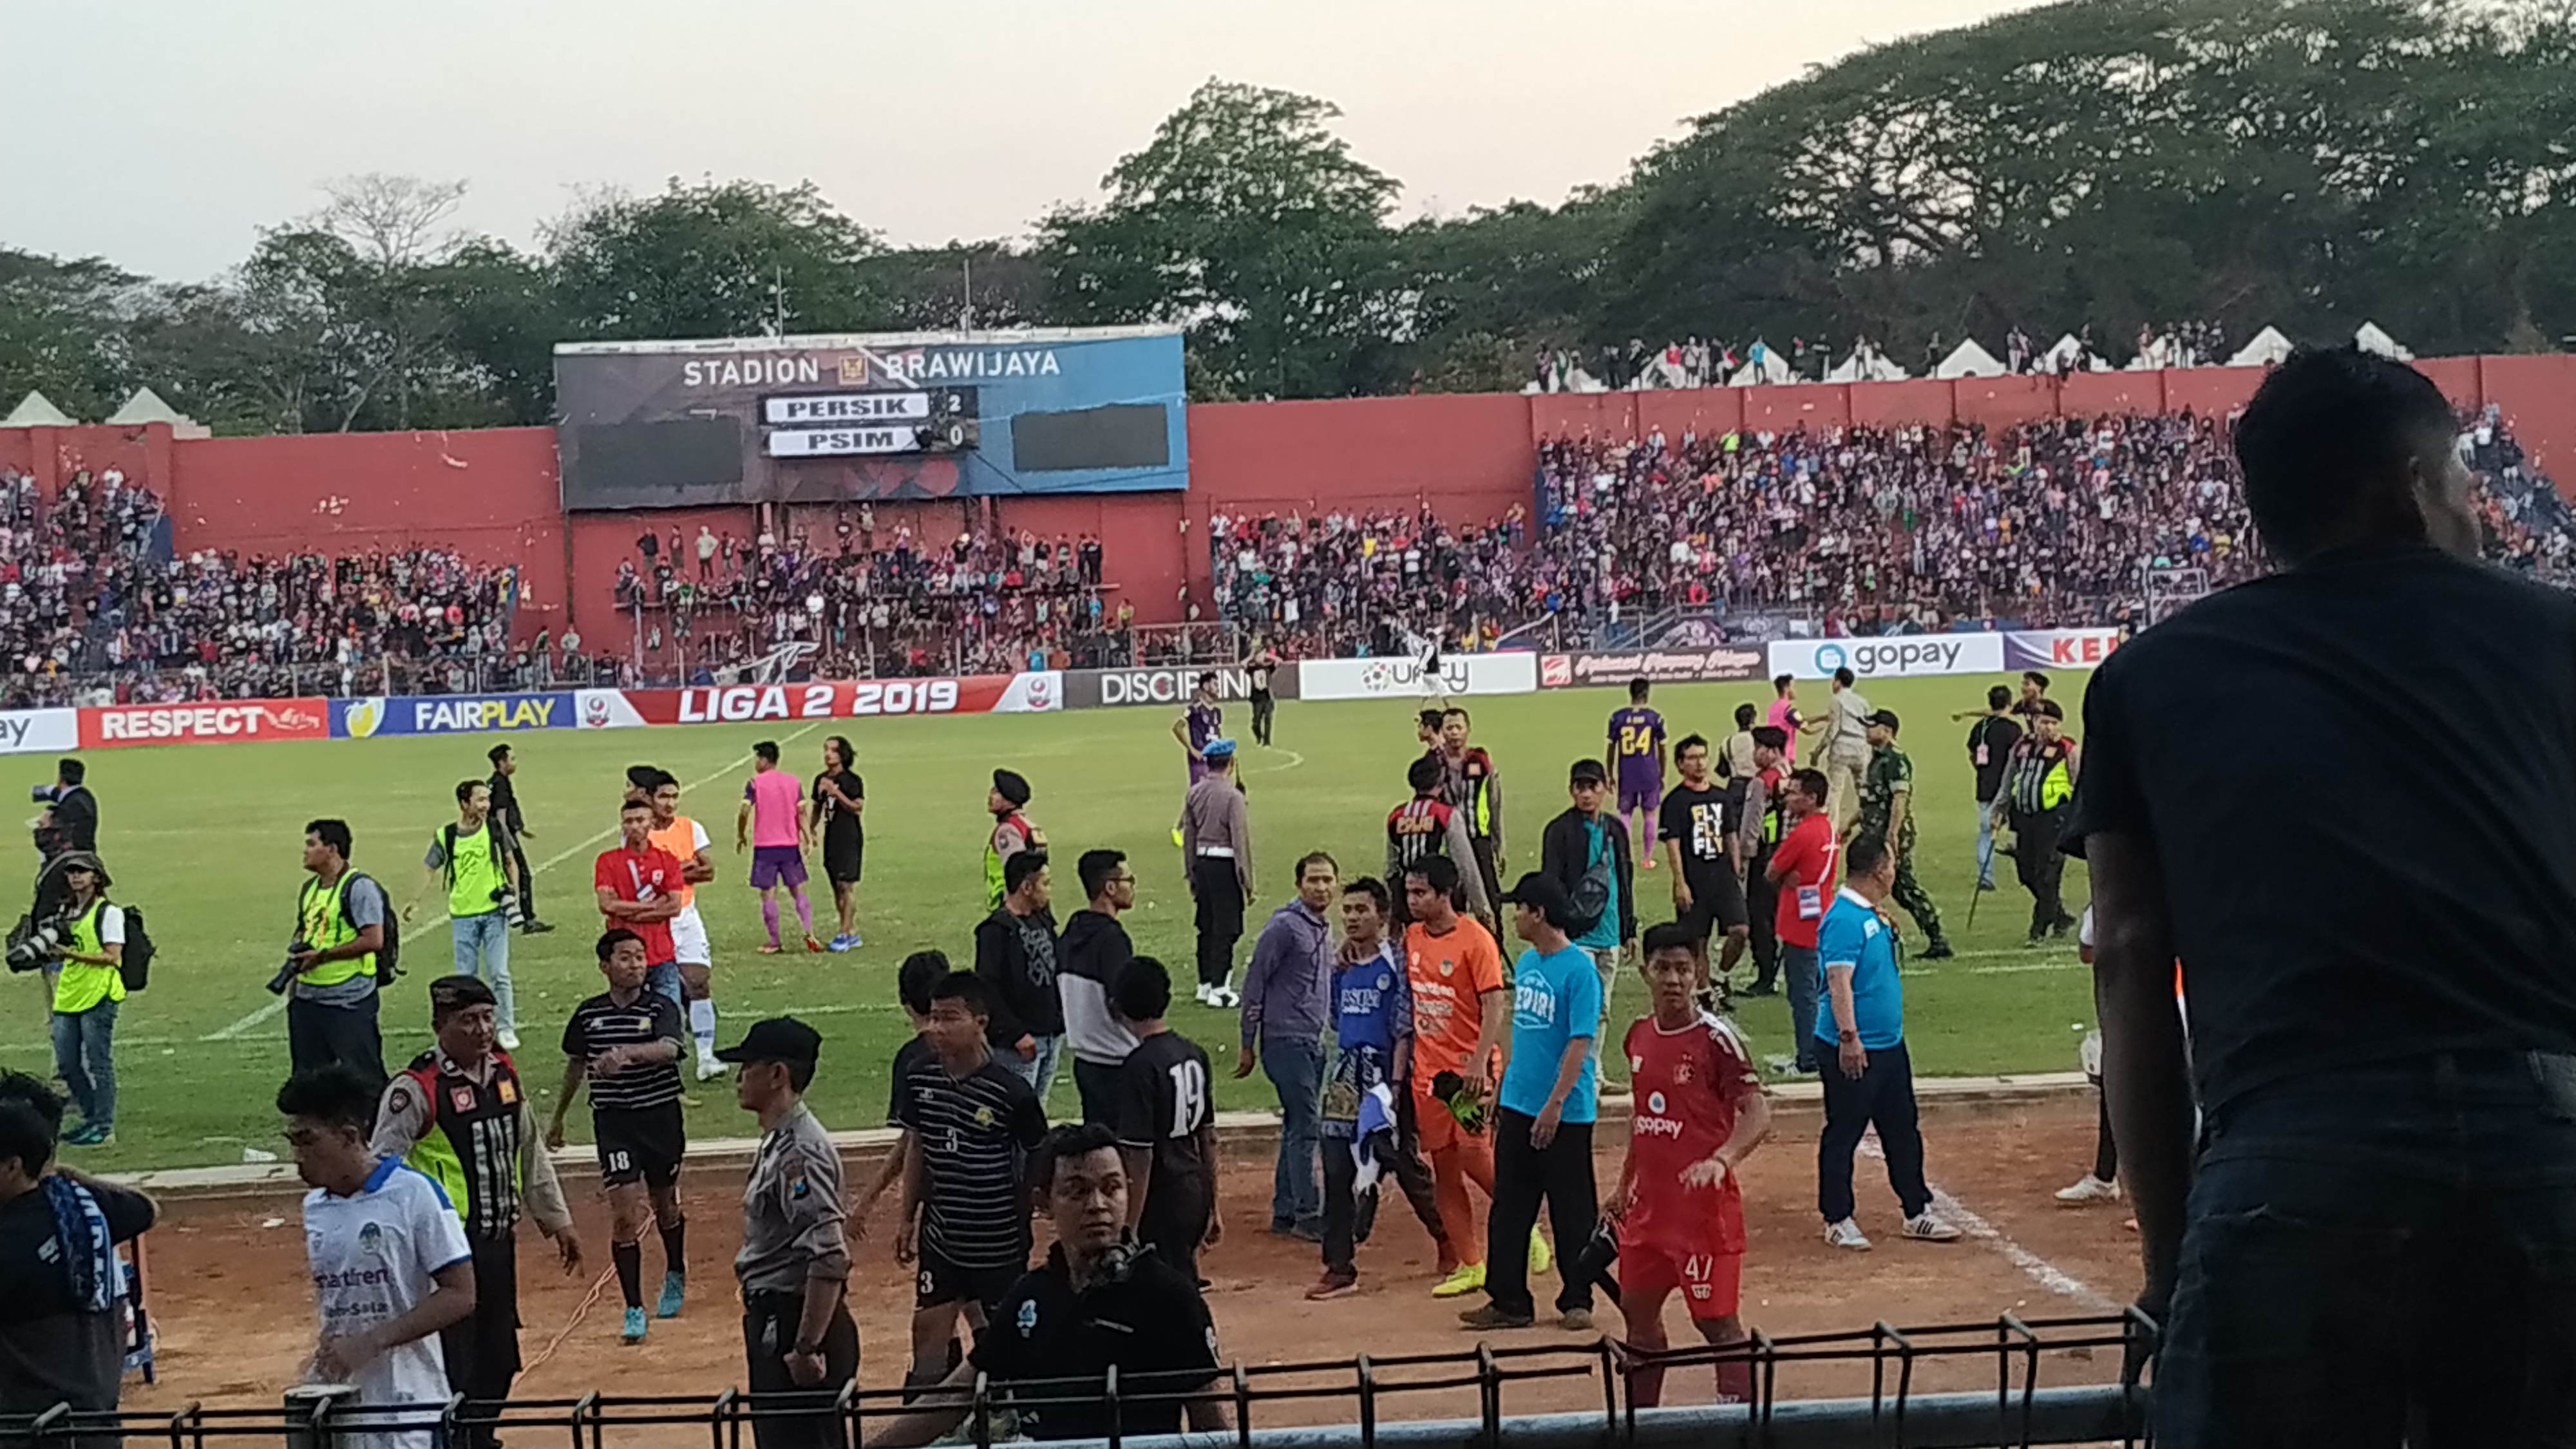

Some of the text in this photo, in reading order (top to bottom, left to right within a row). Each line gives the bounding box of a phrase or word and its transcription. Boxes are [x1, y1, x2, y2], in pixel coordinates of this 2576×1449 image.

[683, 350, 1061, 386] STADION BRAWIJAYA
[788, 395, 961, 418] PERSIK 2
[808, 431, 894, 450] PSIM
[1855, 643, 1962, 674] gopay
[1101, 668, 1251, 704] DISCIPIN
[415, 698, 556, 730] FAIRPLAY
[678, 680, 959, 723] LIGA 2 2019
[102, 706, 264, 739] RESPECT
[1620, 726, 1652, 756] 24
[1690, 803, 1723, 822] FLY
[1693, 820, 1723, 838] FLY
[1693, 837, 1723, 855] FLY
[1514, 985, 1556, 1025] EDIRI
[1169, 1059, 1206, 1138] 19
[945, 1127, 958, 1152] 3
[608, 1151, 630, 1172] 18
[1685, 1254, 1713, 1281] 47
[920, 1271, 934, 1293] 3
